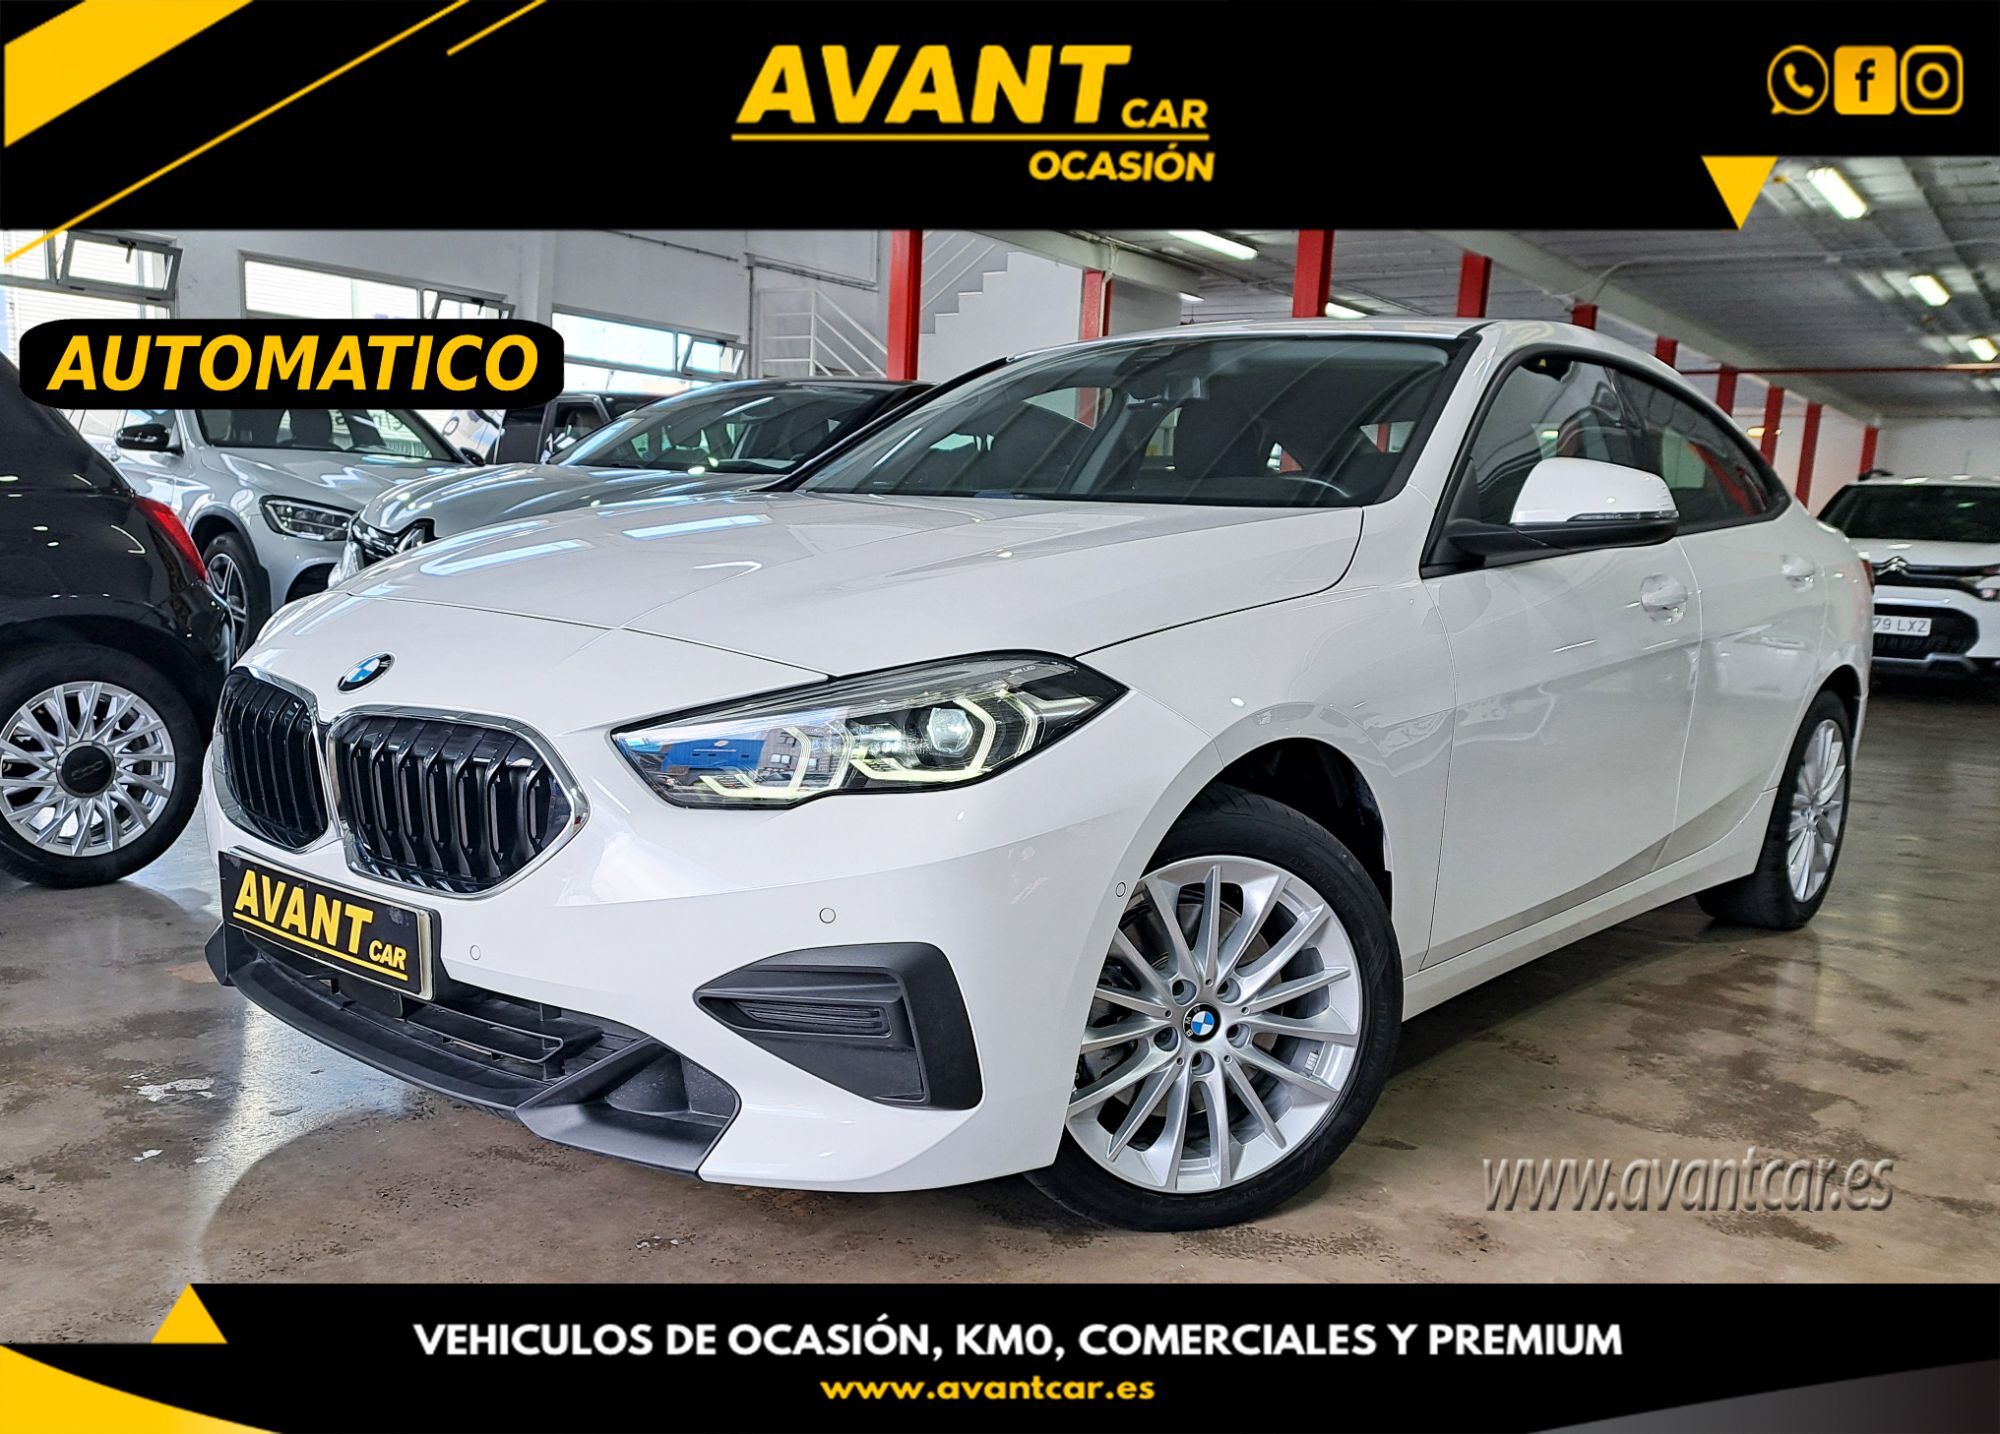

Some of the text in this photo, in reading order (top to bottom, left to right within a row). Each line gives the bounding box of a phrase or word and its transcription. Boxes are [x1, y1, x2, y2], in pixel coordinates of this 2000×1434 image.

[1896, 620, 1928, 633] LXZ
[233, 869, 408, 971] AVANT CAR
